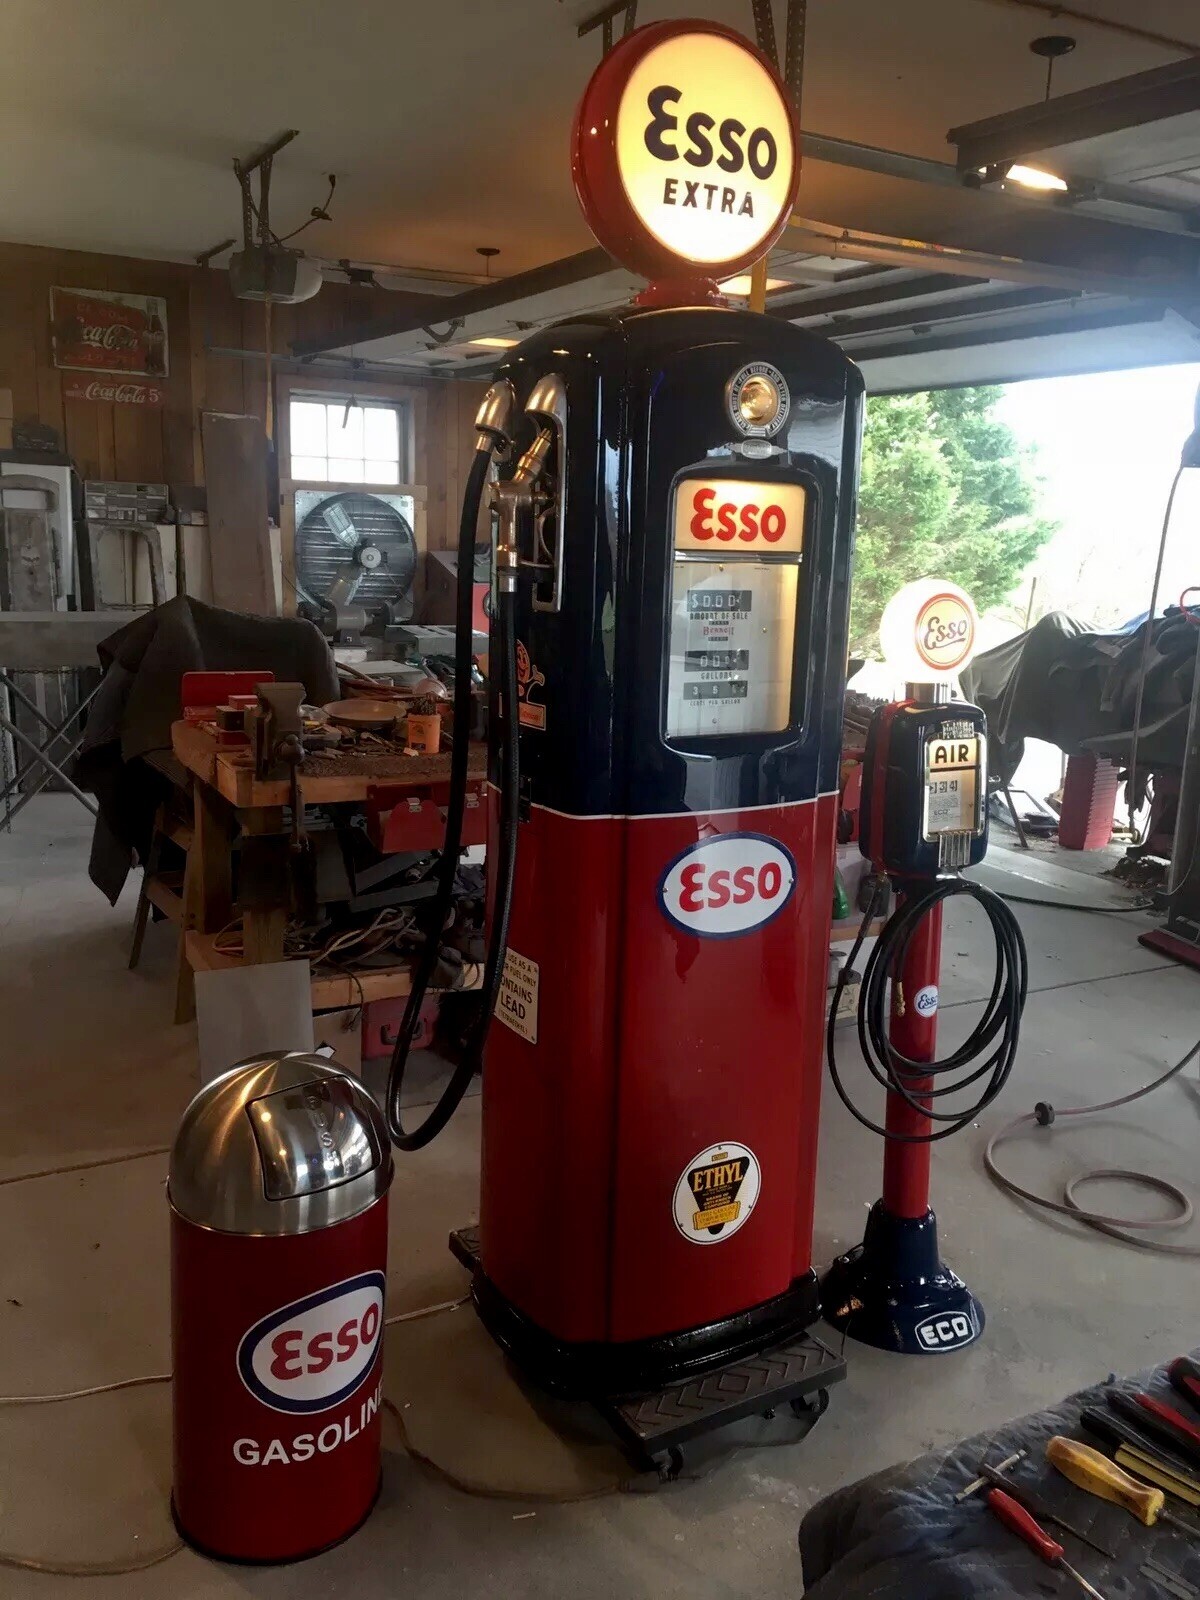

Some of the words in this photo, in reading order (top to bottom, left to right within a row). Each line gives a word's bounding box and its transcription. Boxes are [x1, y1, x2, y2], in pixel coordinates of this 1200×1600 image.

[663, 178, 754, 218] EXTRA
[690, 612, 718, 620] AMOUNT
[721, 612, 729, 620] OF
[732, 612, 748, 620] SALE
[924, 616, 967, 650] Esso
[701, 672, 733, 680] GALLONS
[935, 744, 969, 764] AIR
[510, 966, 522, 980] FUEL
[523, 974, 536, 988] ONLY
[501, 991, 526, 1020] LEAD
[693, 1161, 744, 1193] ETHYL
[921, 1316, 968, 1345] ECO
